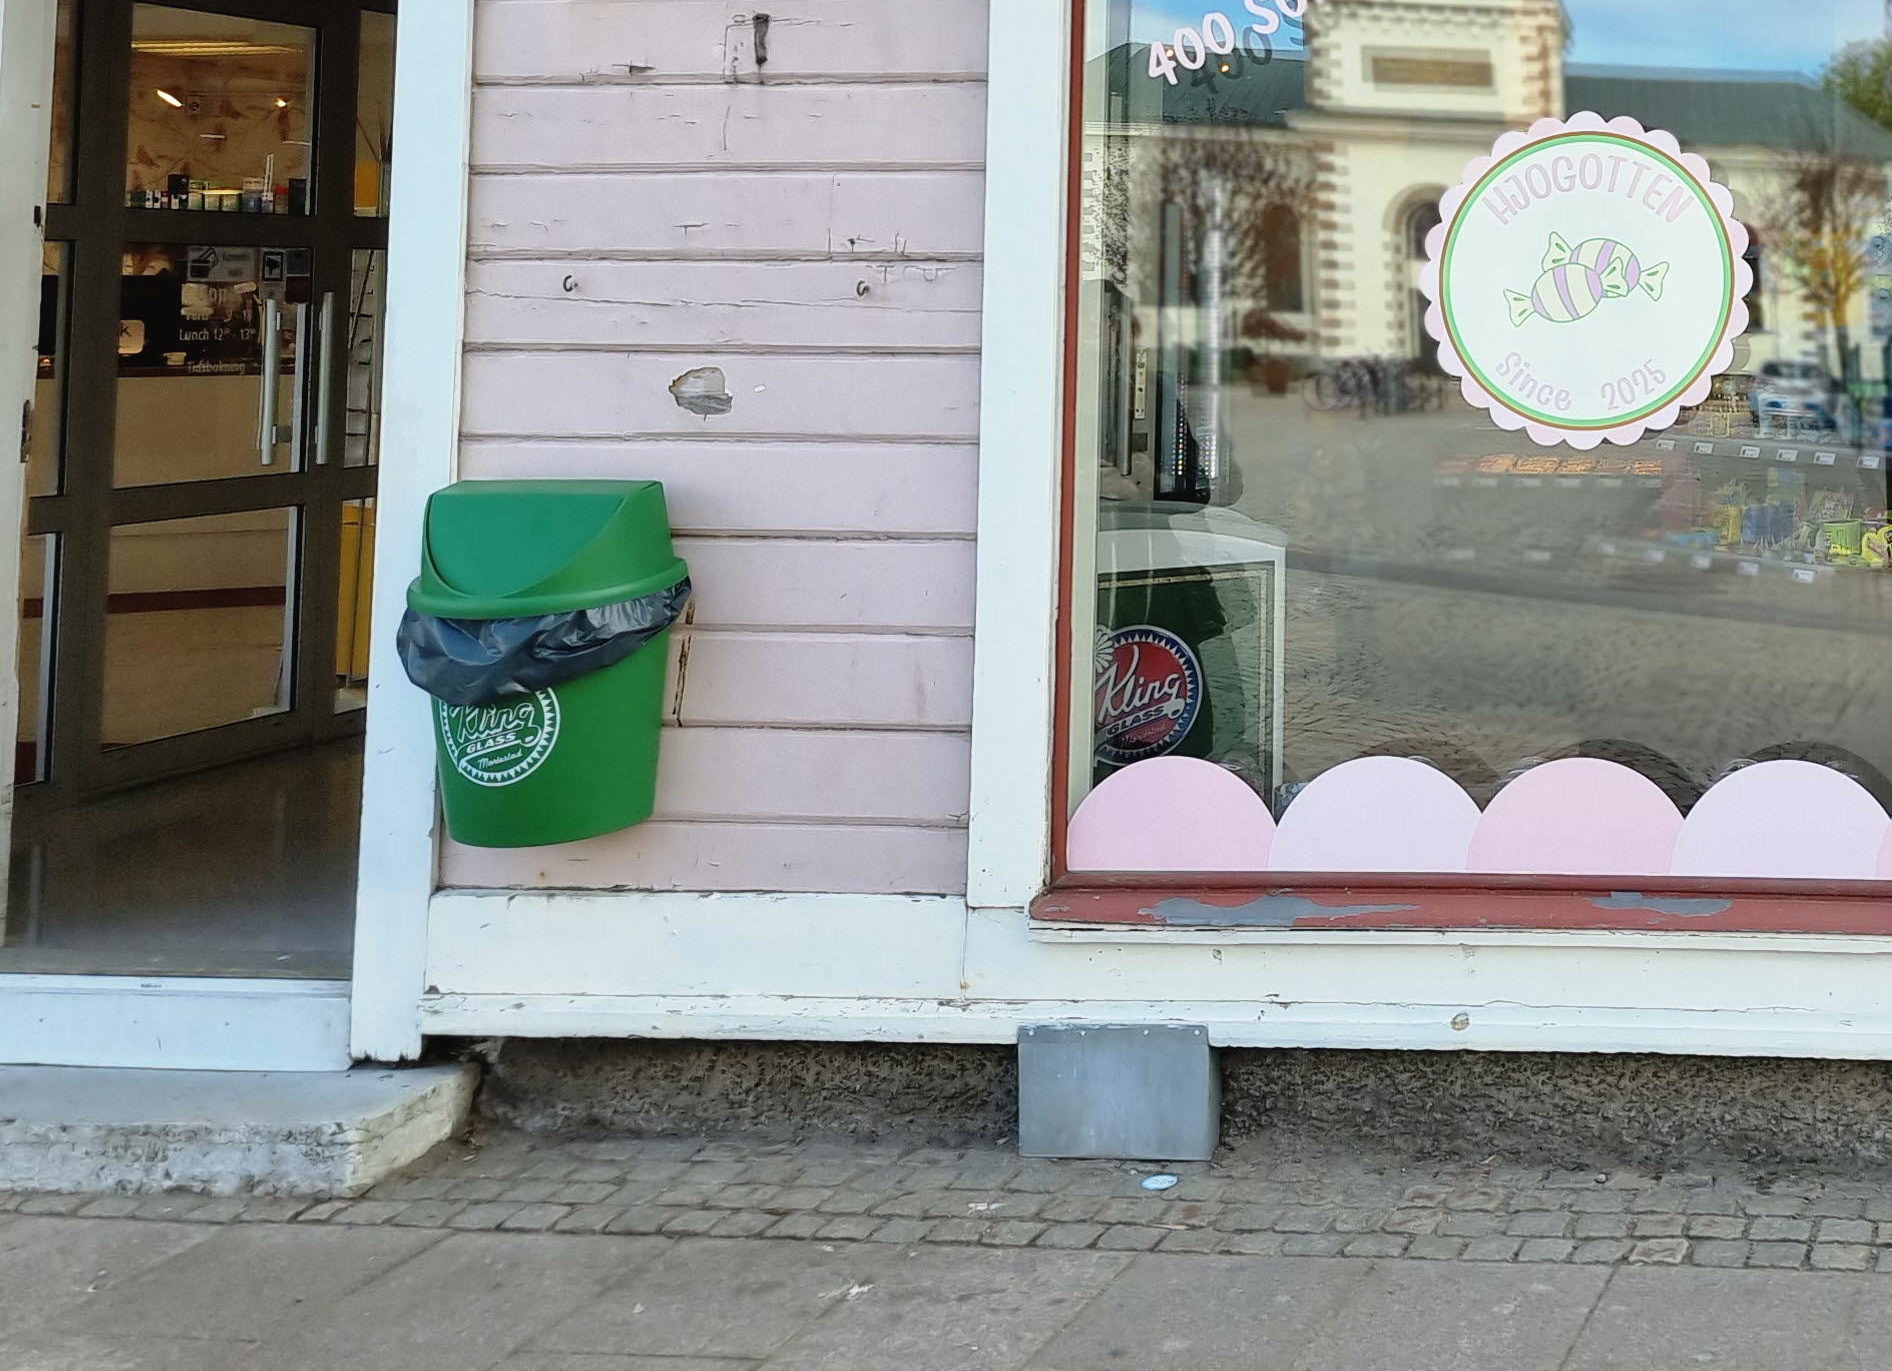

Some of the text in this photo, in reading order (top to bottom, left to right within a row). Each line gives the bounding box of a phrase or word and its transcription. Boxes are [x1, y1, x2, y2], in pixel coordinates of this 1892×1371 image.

[1148, 11, 1235, 86] 400
[1481, 153, 1696, 225] HJOGOTTEN
[180, 329, 209, 341] Lunch
[1496, 350, 1667, 412] Since 2025
[1095, 644, 1182, 724] Kling
[466, 732, 517, 754] GLASS
[1107, 707, 1164, 735] GLASS
